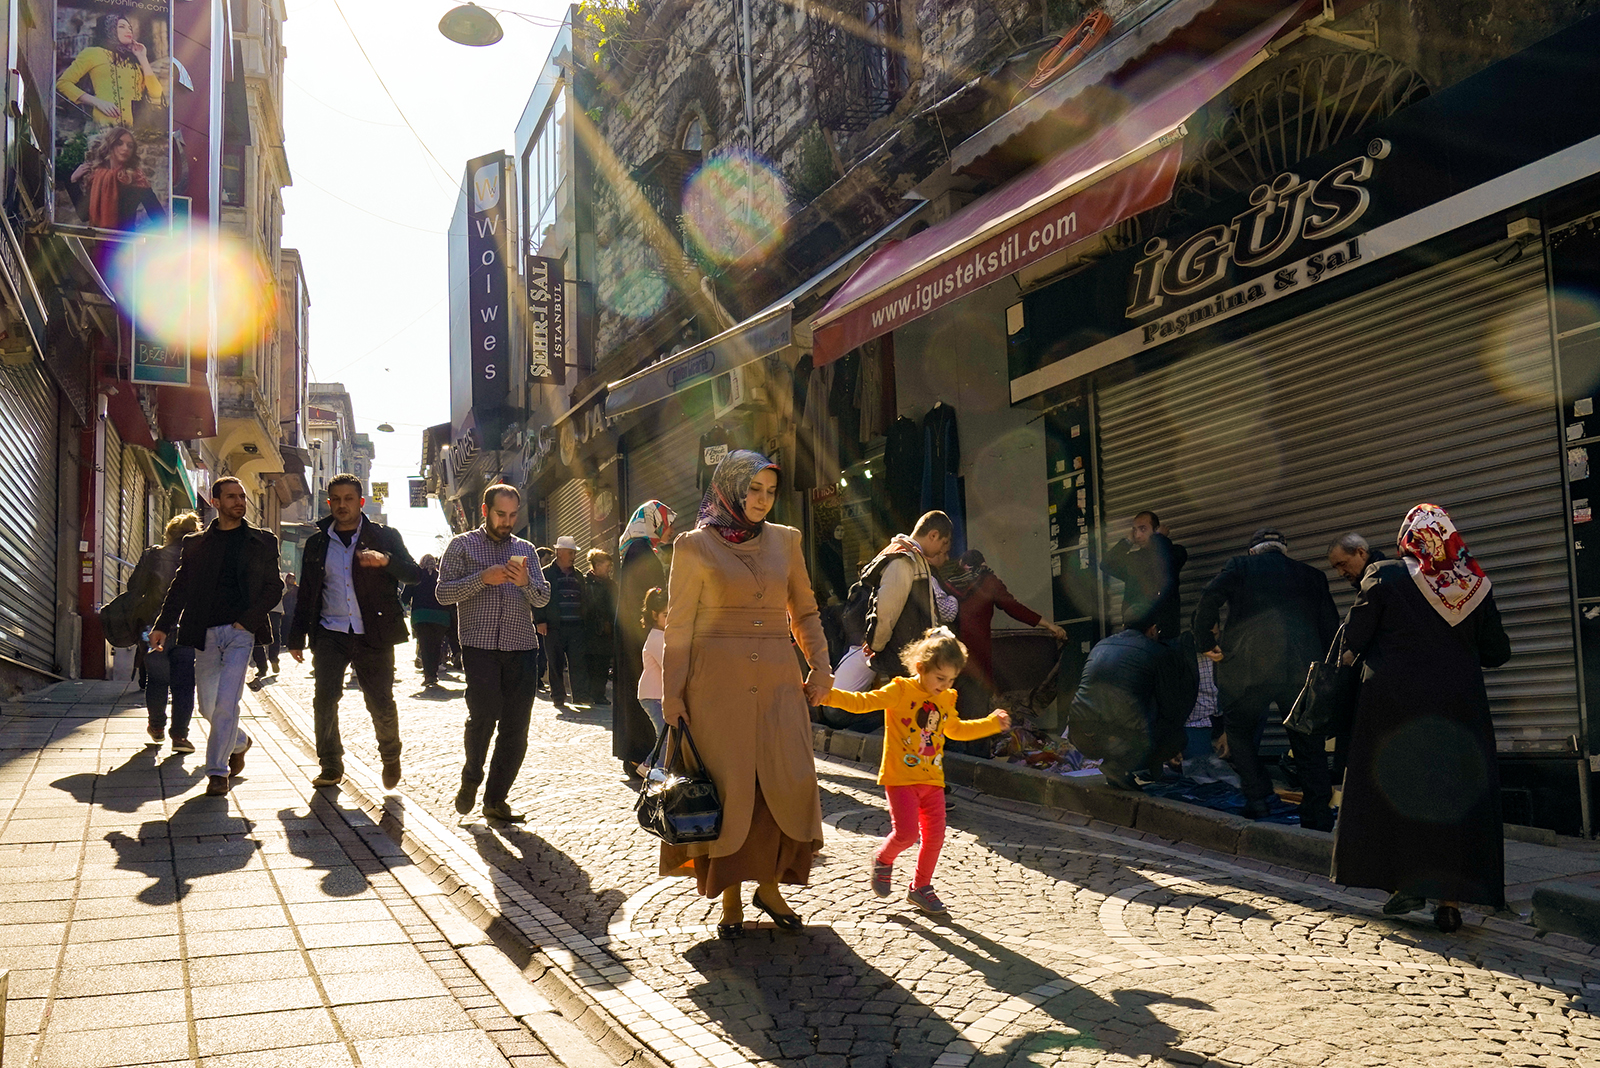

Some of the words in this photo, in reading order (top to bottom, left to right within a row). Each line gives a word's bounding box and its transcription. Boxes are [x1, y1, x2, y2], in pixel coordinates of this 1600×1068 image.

[530, 261, 551, 302] ŞAL
[871, 211, 1077, 329] www.igustekstil.com
[1125, 156, 1374, 318] İGÜS
[1142, 280, 1266, 344] Paşmina
[1273, 268, 1299, 292] &
[1306, 237, 1362, 283] Şal
[476, 214, 499, 380] Wolwes
[529, 304, 552, 378] ŞEHR-İ
[554, 284, 562, 358] İSTANBUL
